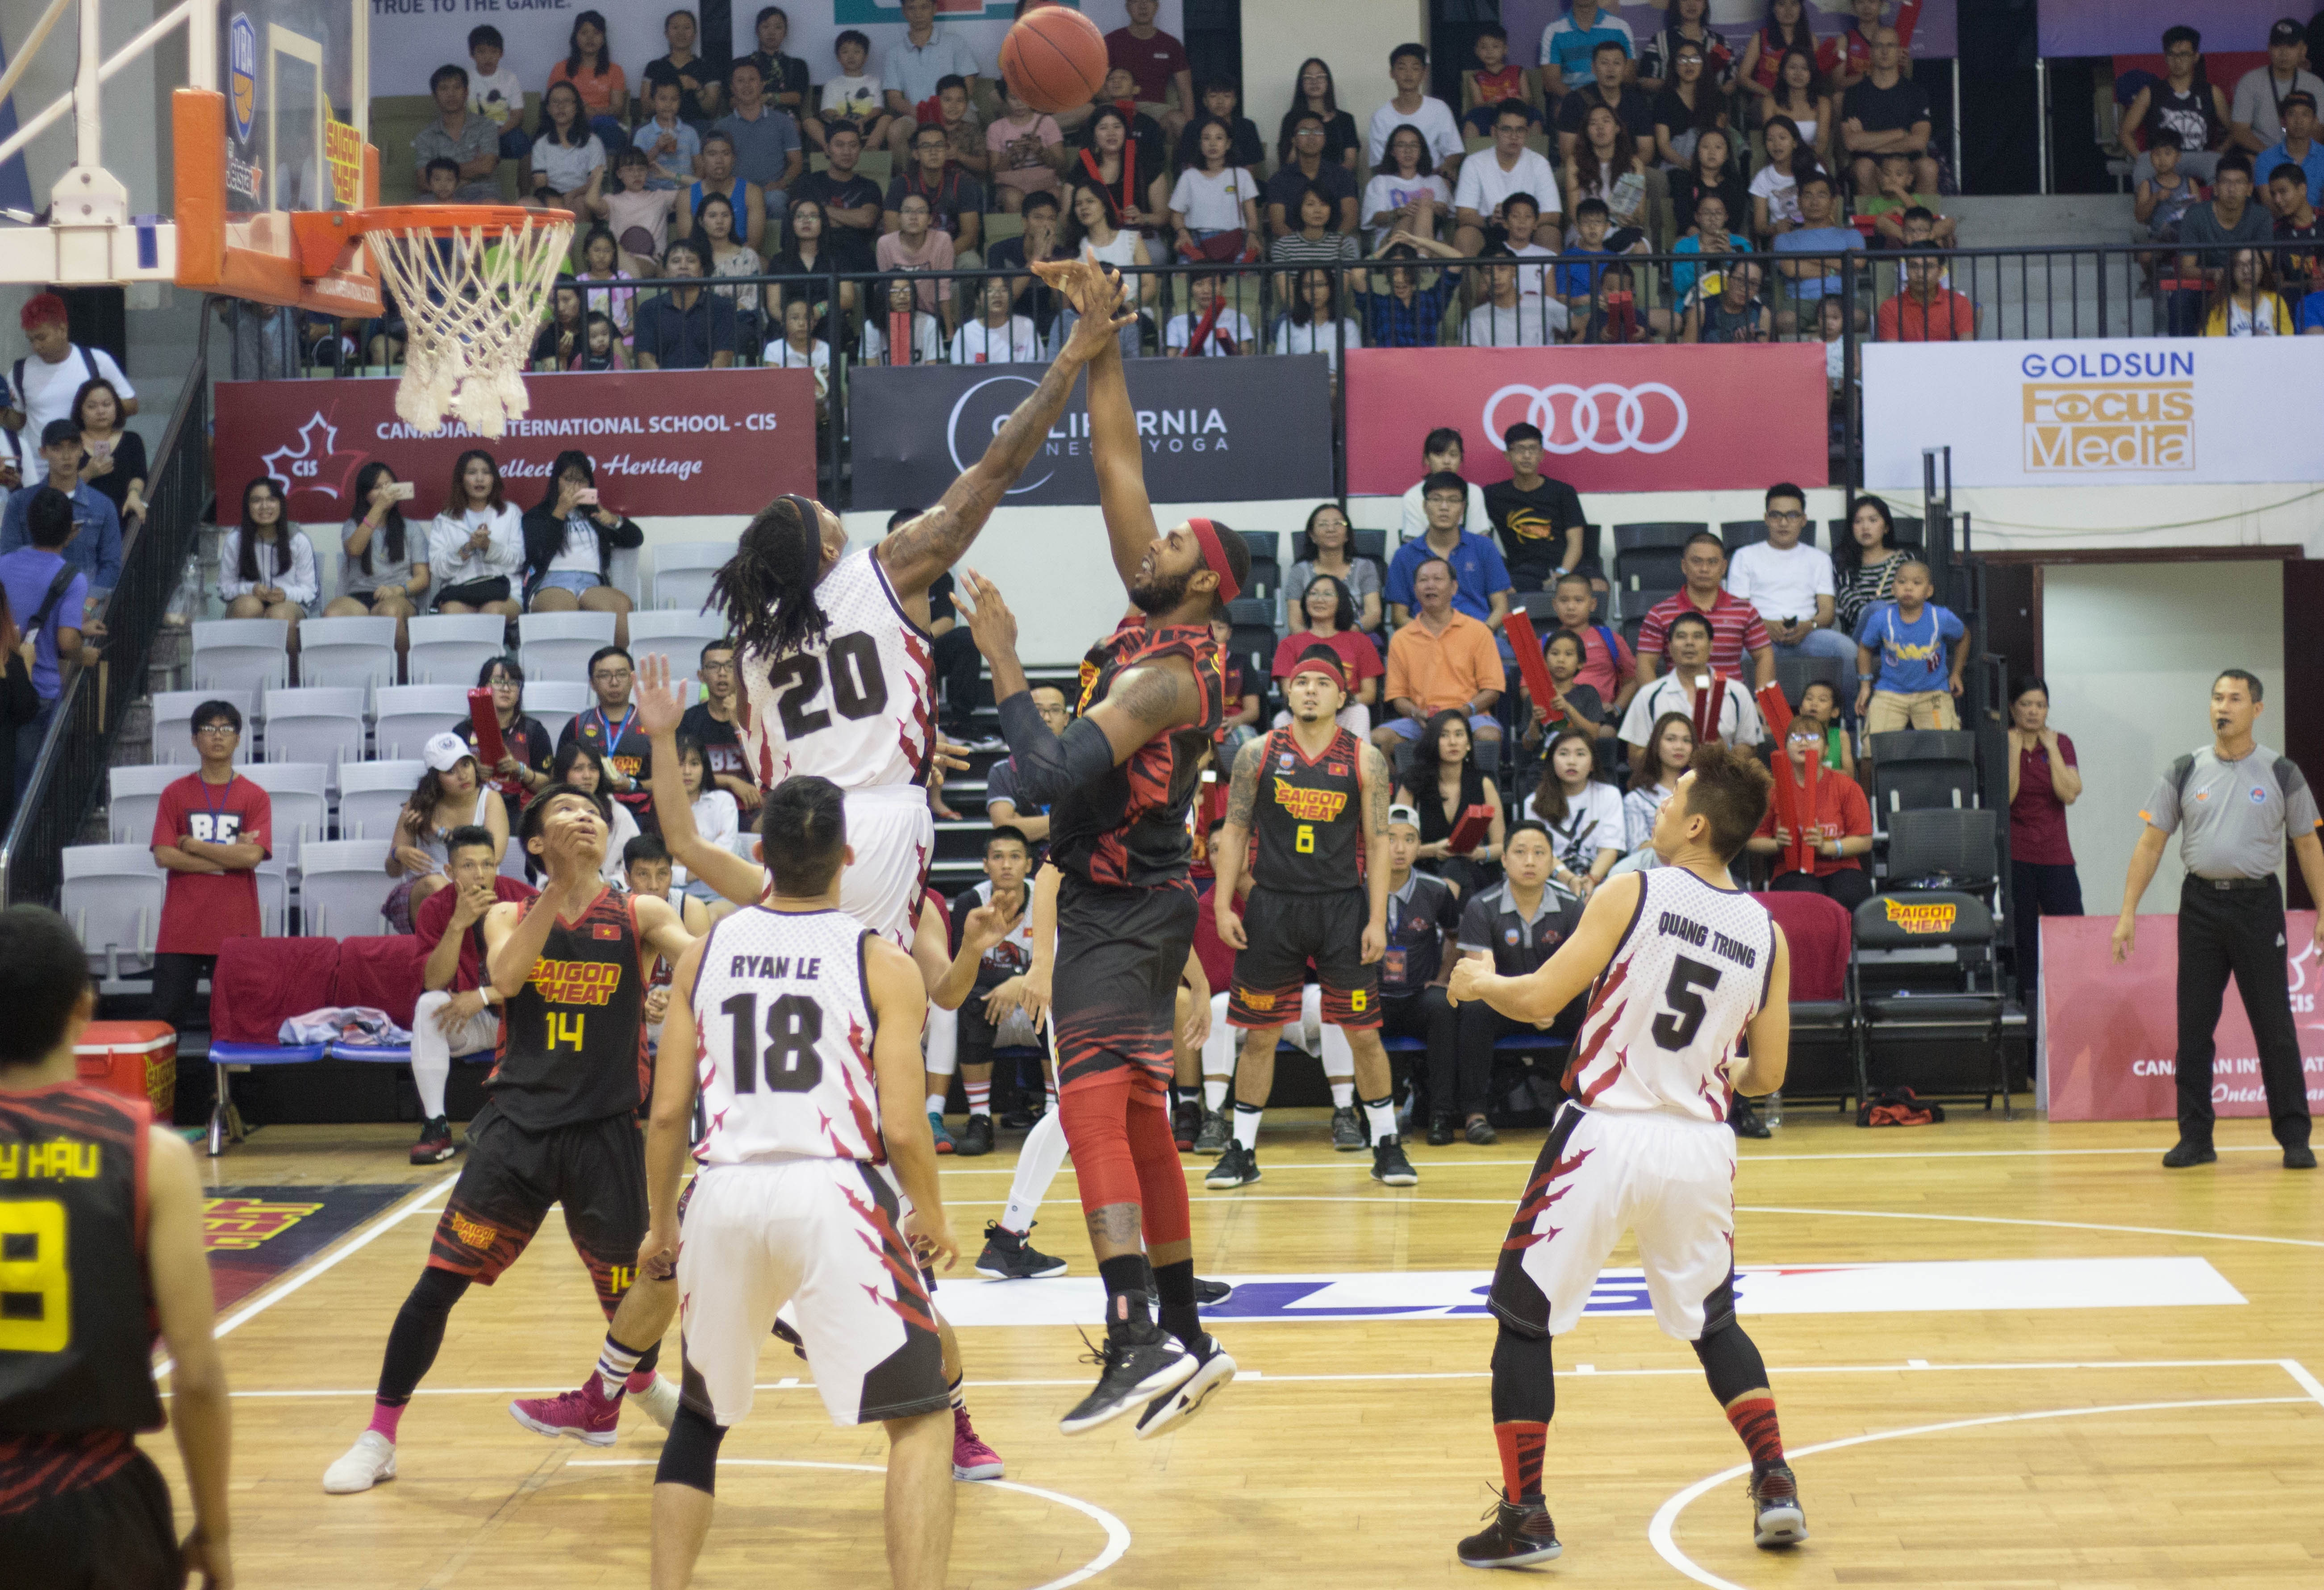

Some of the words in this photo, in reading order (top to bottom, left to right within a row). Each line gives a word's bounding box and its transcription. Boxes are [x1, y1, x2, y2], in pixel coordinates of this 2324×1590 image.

[373, 0, 425, 14] TRUE
[432, 0, 455, 12] TO
[464, 0, 500, 12] THE
[234, 25, 253, 76] VBA
[2022, 351, 2194, 378] GOLDSUN
[2022, 381, 2194, 423] Focus
[649, 414, 730, 434] SCHOOL
[745, 413, 777, 432] CIS
[1148, 437, 1229, 453] YOGA
[2024, 423, 2192, 468] Media
[292, 459, 318, 477] CIS
[602, 454, 702, 481] Heritage
[768, 630, 888, 741] 20
[1276, 789, 1347, 808] SAIGON
[1293, 803, 1342, 822] HEAT
[1296, 825, 1314, 853] 6
[1888, 905, 1956, 921] SAIGON
[1907, 919, 1954, 934] HEAT
[1657, 911, 1709, 947] QUANG
[1711, 930, 1757, 969] TRUNG
[730, 955, 790, 979] RYAN
[796, 957, 821, 980] LE
[545, 981, 617, 1006] HEAT
[1351, 989, 1367, 1012] 6
[1652, 953, 1723, 1052] 5
[546, 1012, 584, 1052] 14
[721, 992, 824, 1095] 18
[28, 1136, 98, 1183] HẬU
